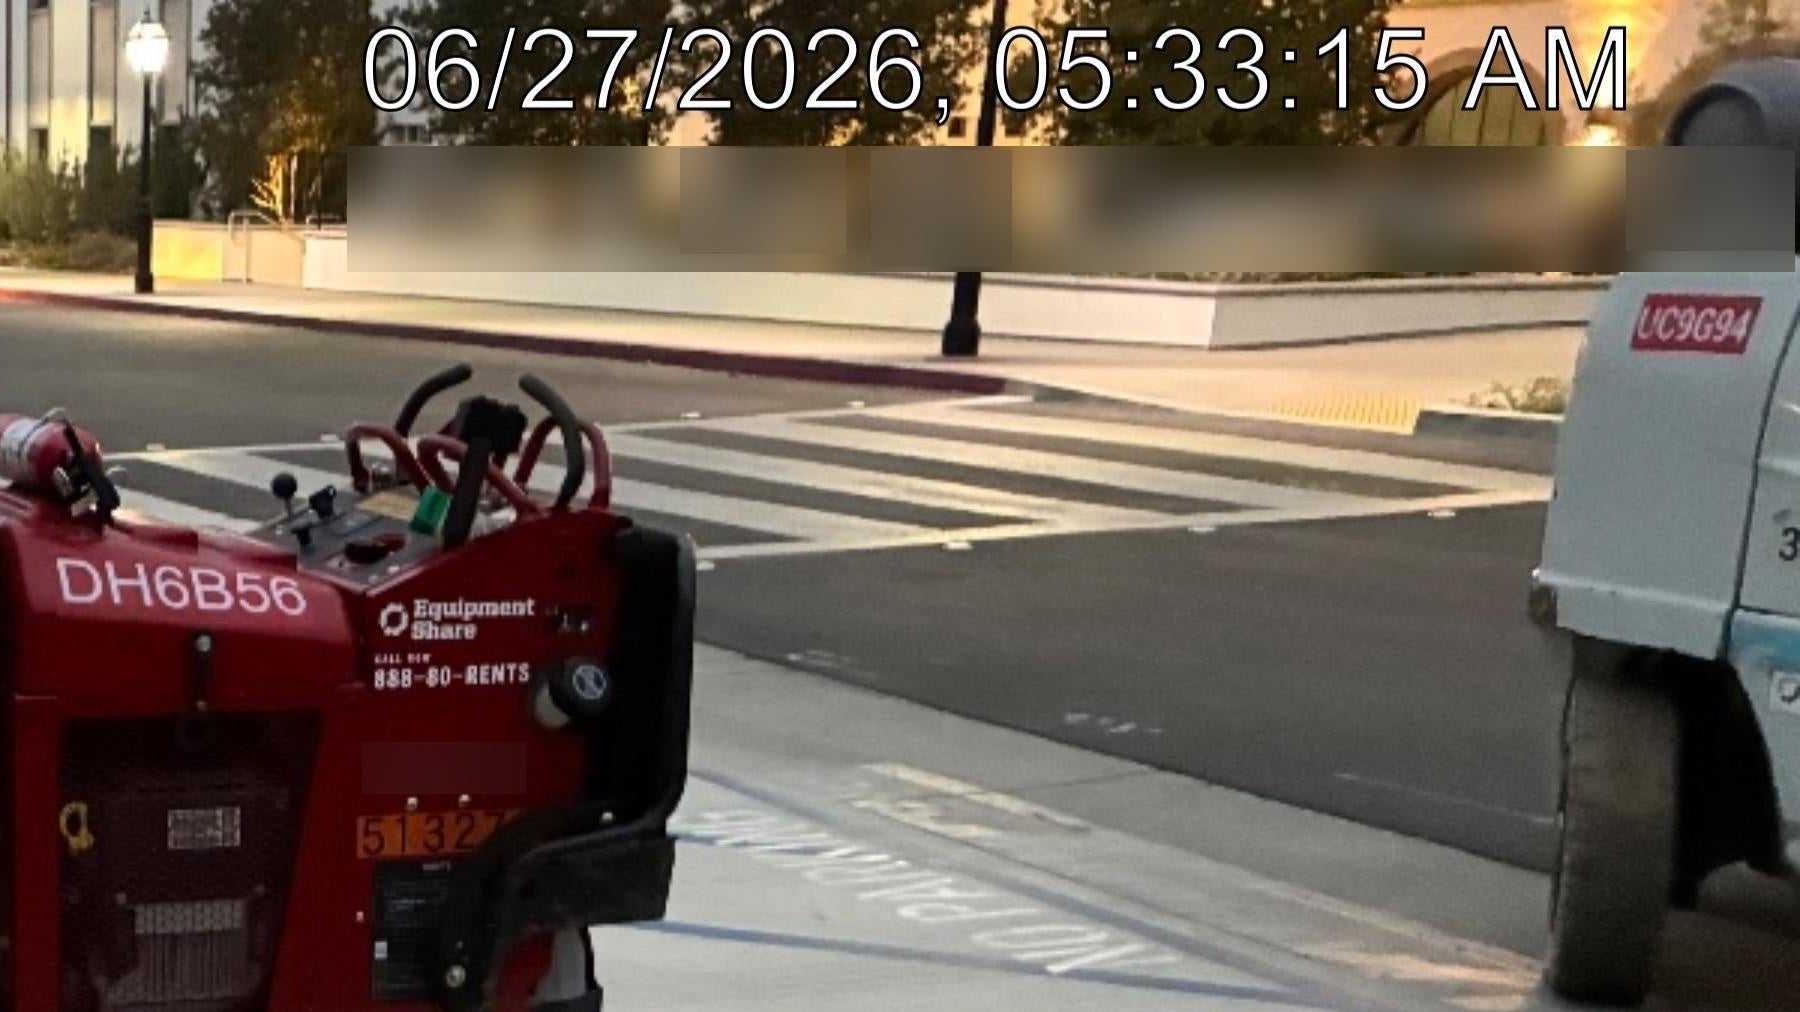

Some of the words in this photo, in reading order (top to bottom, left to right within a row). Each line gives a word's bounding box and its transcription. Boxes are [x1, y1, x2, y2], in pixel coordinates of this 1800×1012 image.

[1636, 304, 1753, 343] UC9G94
[1779, 527, 1800, 561] 3
[56, 556, 307, 616] DH6B56
[412, 596, 536, 622] Equipment
[410, 619, 478, 640] Share
[373, 662, 531, 690] 888-80-RENTS
[970, 925, 1184, 974] NO
